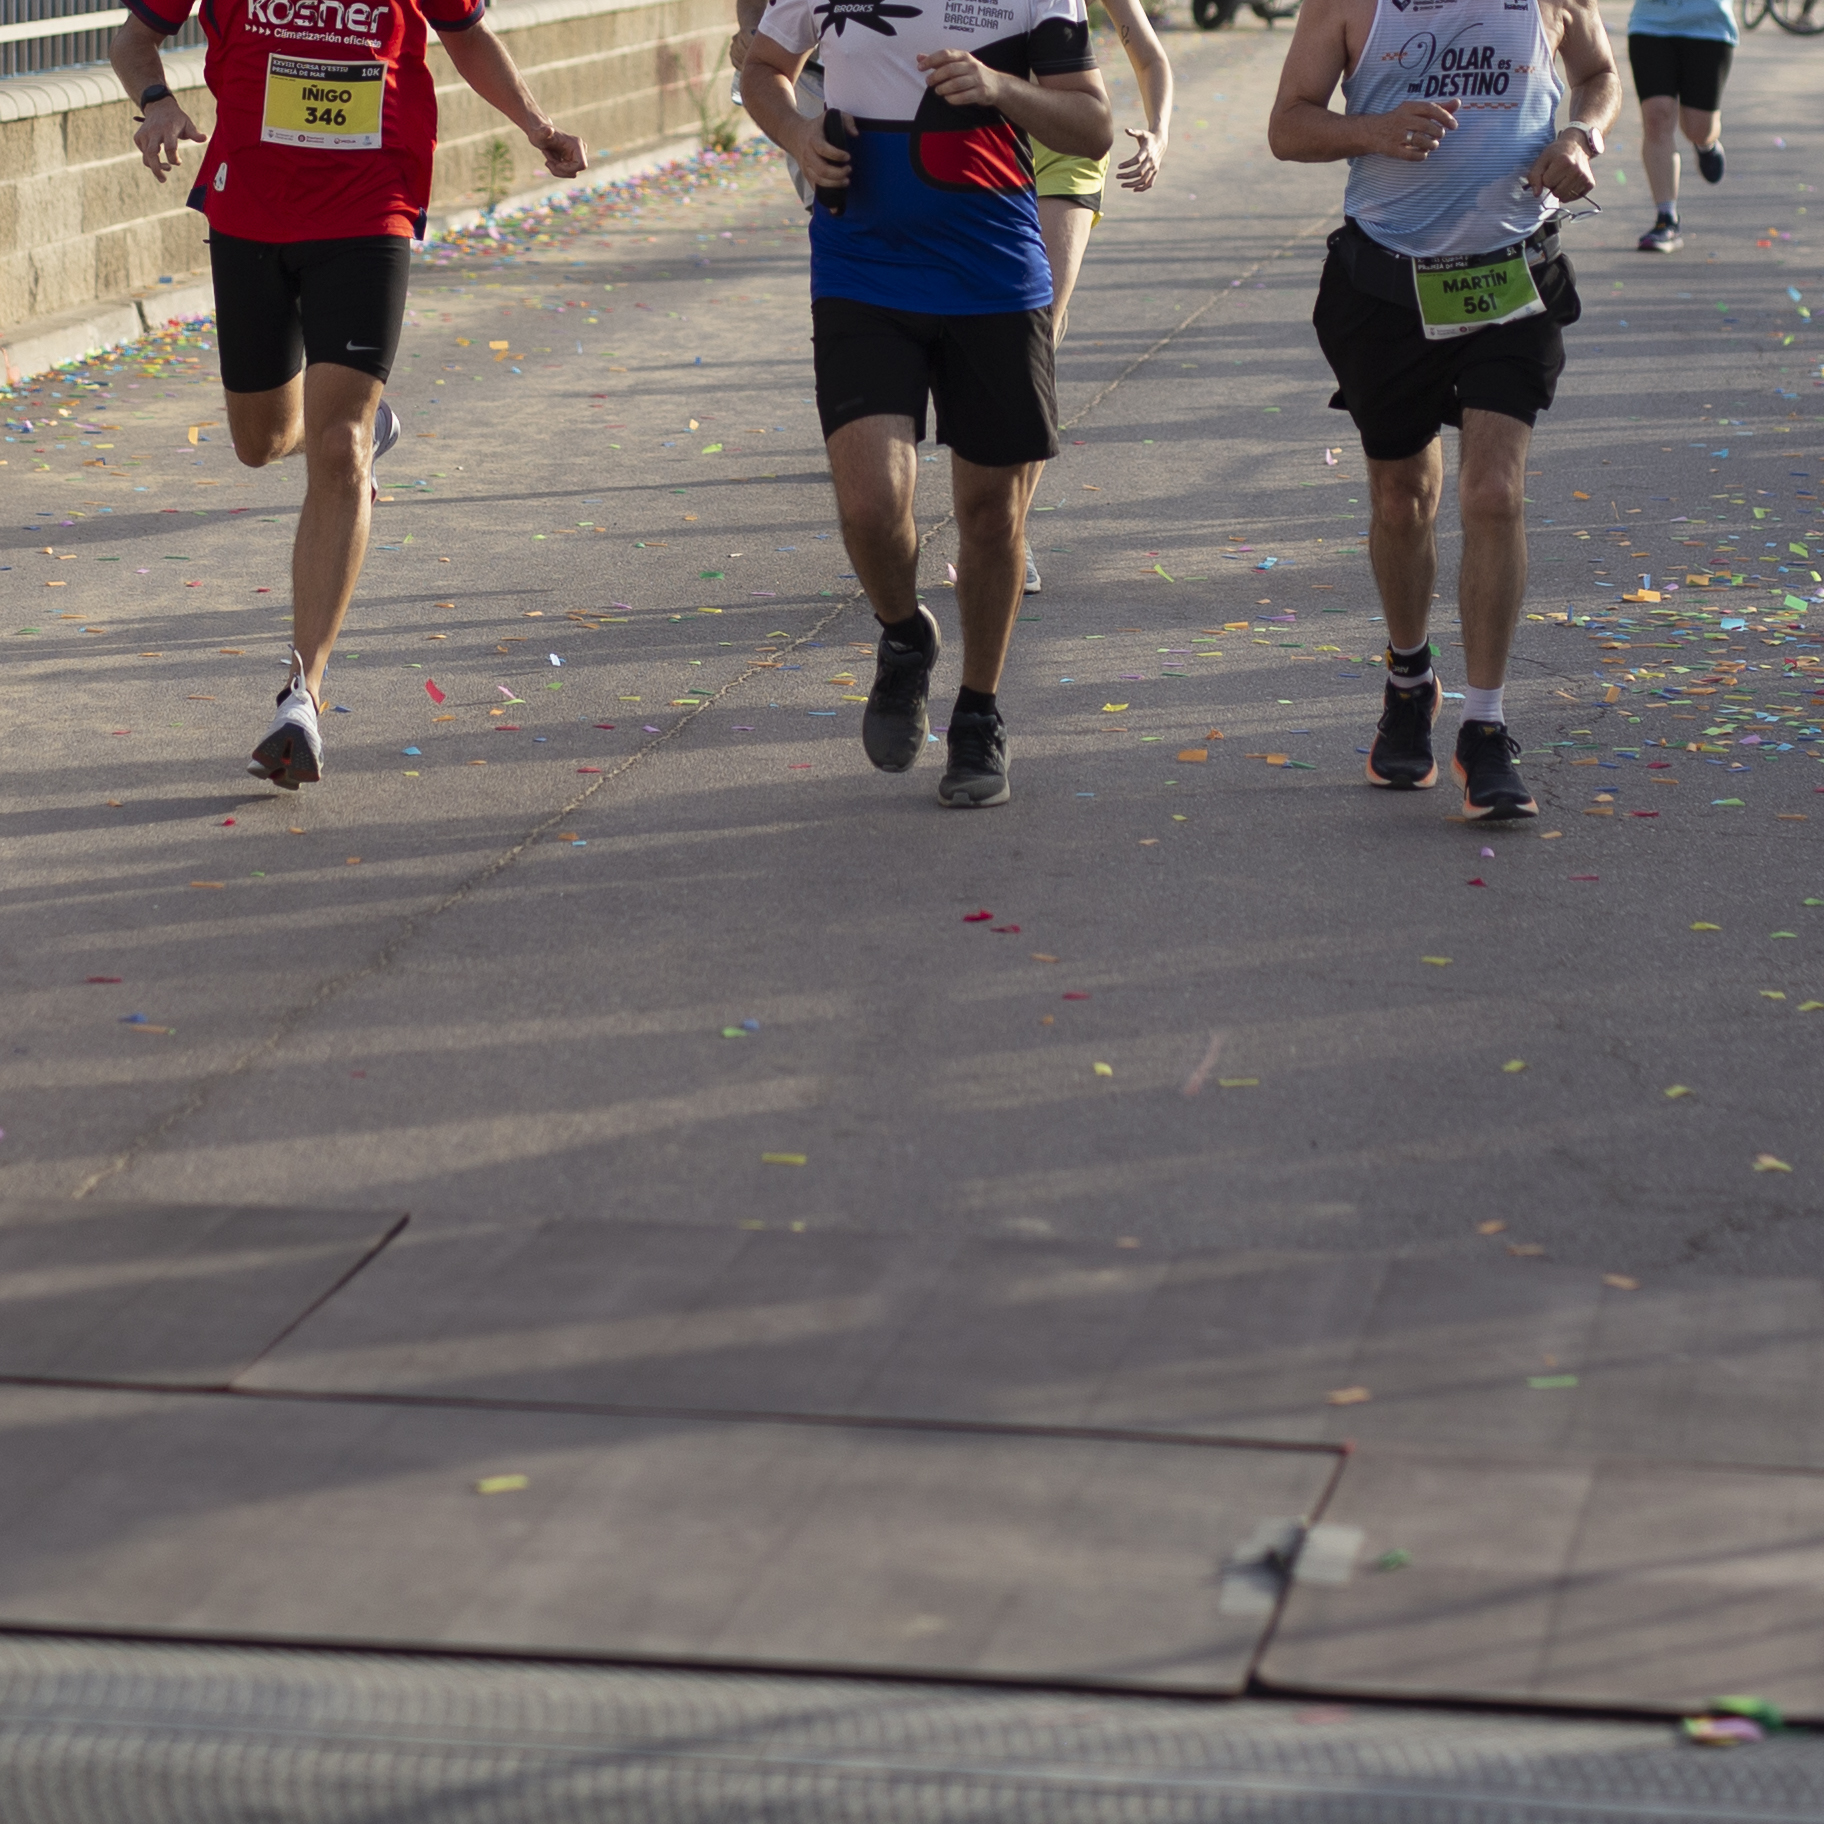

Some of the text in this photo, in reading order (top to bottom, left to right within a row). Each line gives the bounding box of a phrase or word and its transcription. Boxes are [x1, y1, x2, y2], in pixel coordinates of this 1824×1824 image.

[833, 4, 874, 13] BROOKS
[945, 2, 974, 14] MITJA
[944, 13, 998, 30] BARCELONA
[362, 67, 380, 77] 10K
[1497, 58, 1512, 70] es
[302, 84, 352, 103] IÑIGO
[1424, 72, 1510, 98] DESTINO
[304, 106, 347, 126] 346
[1442, 269, 1507, 294] MARTÍN
[1463, 293, 1497, 314] 561
